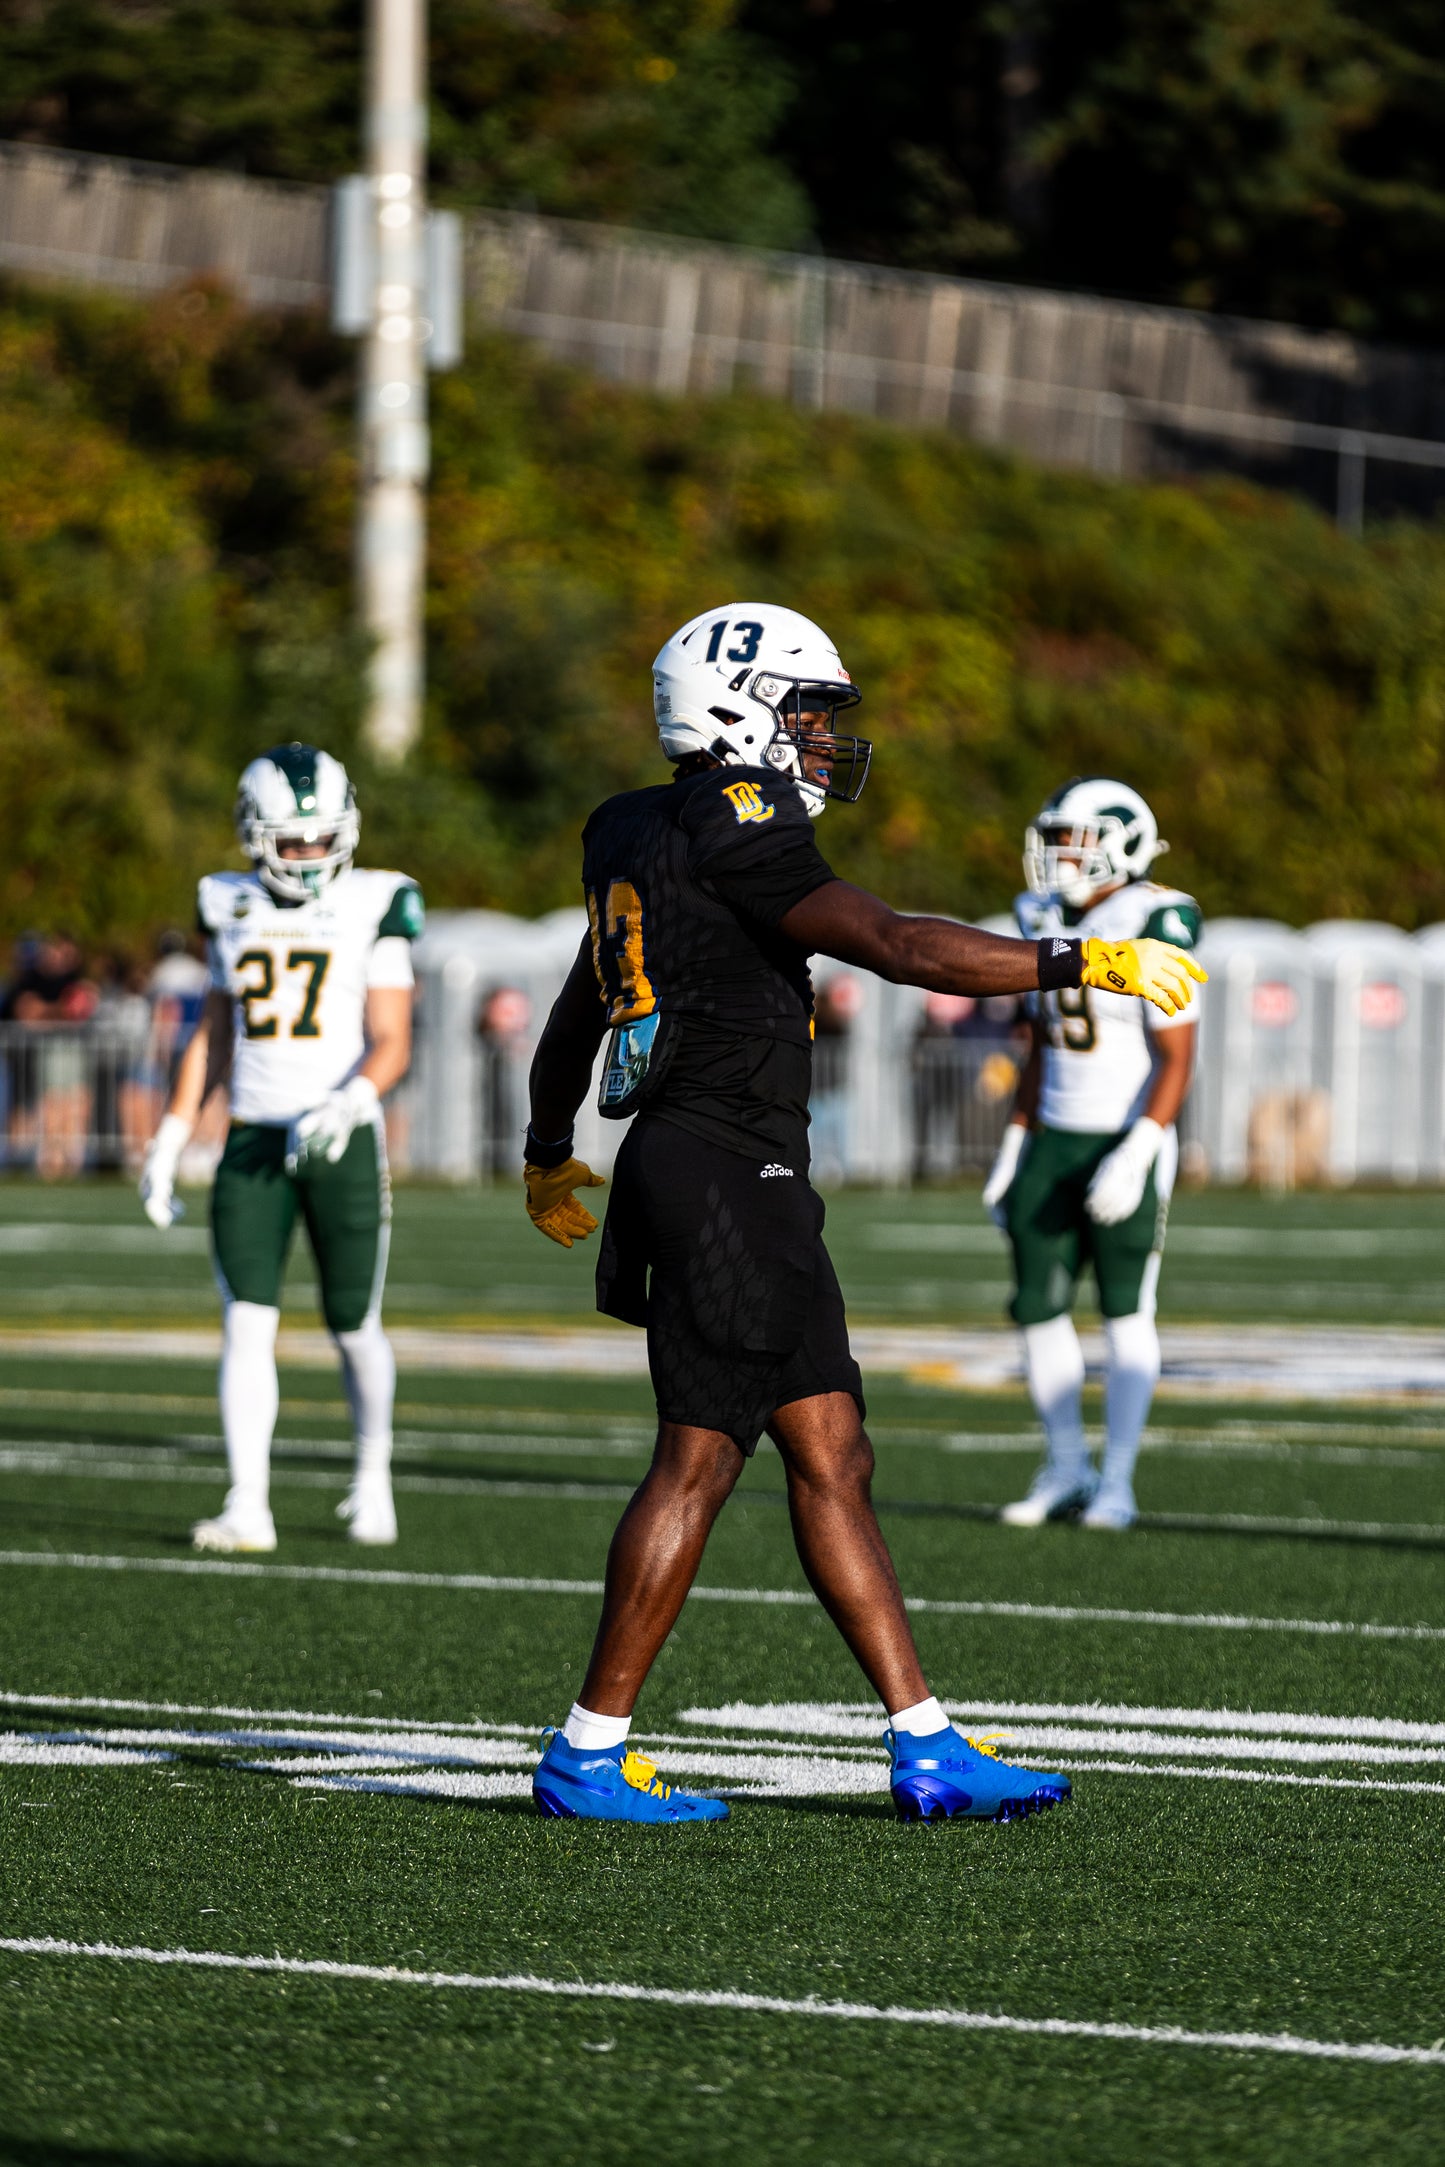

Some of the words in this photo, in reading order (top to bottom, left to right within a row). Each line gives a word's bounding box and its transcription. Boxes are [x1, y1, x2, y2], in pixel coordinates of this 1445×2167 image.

[705, 620, 765, 663] 13
[235, 949, 331, 1039] 27
[760, 1166, 794, 1178] adidas
